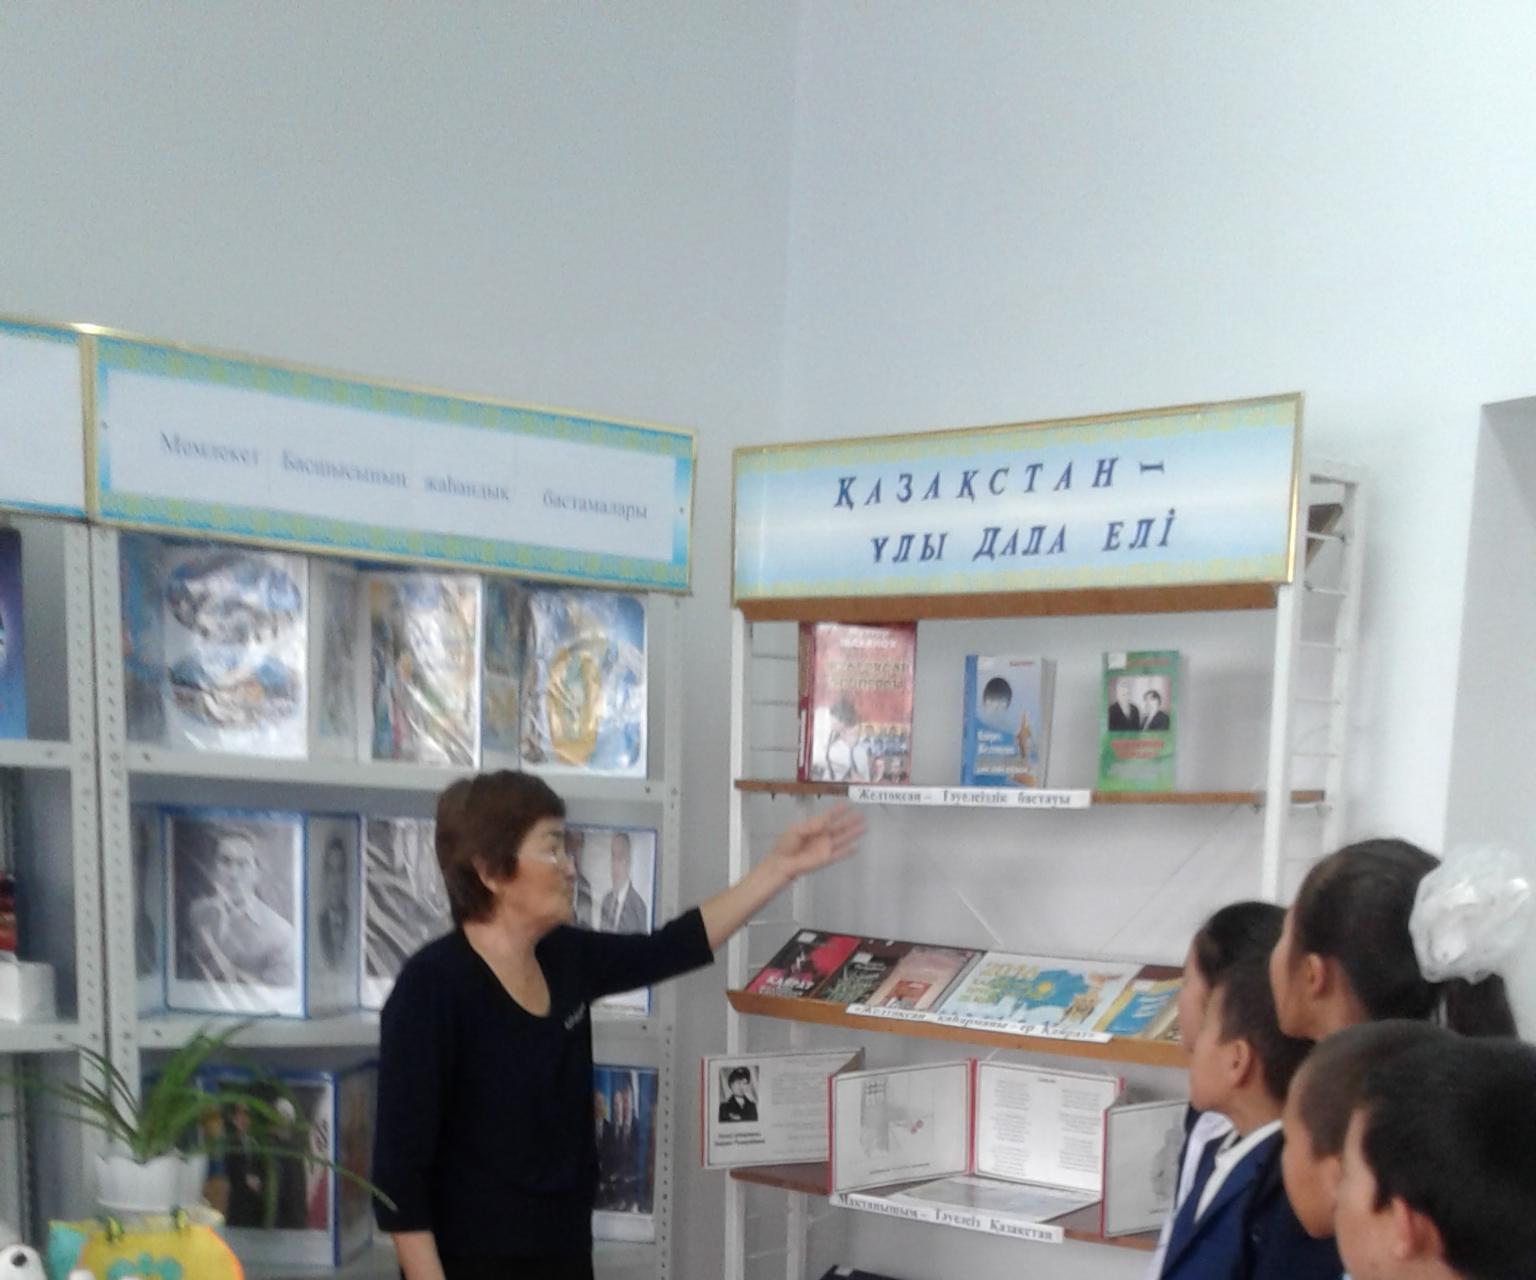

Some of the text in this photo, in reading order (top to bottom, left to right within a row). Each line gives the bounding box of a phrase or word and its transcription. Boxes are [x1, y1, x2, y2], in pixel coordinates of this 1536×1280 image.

[542, 488, 649, 521] бастамалары
[834, 457, 1119, 511] ҚАЗАҚСТАН
[972, 524, 1068, 563] ДАЛА
[1101, 508, 1176, 552] ЕЛІ
